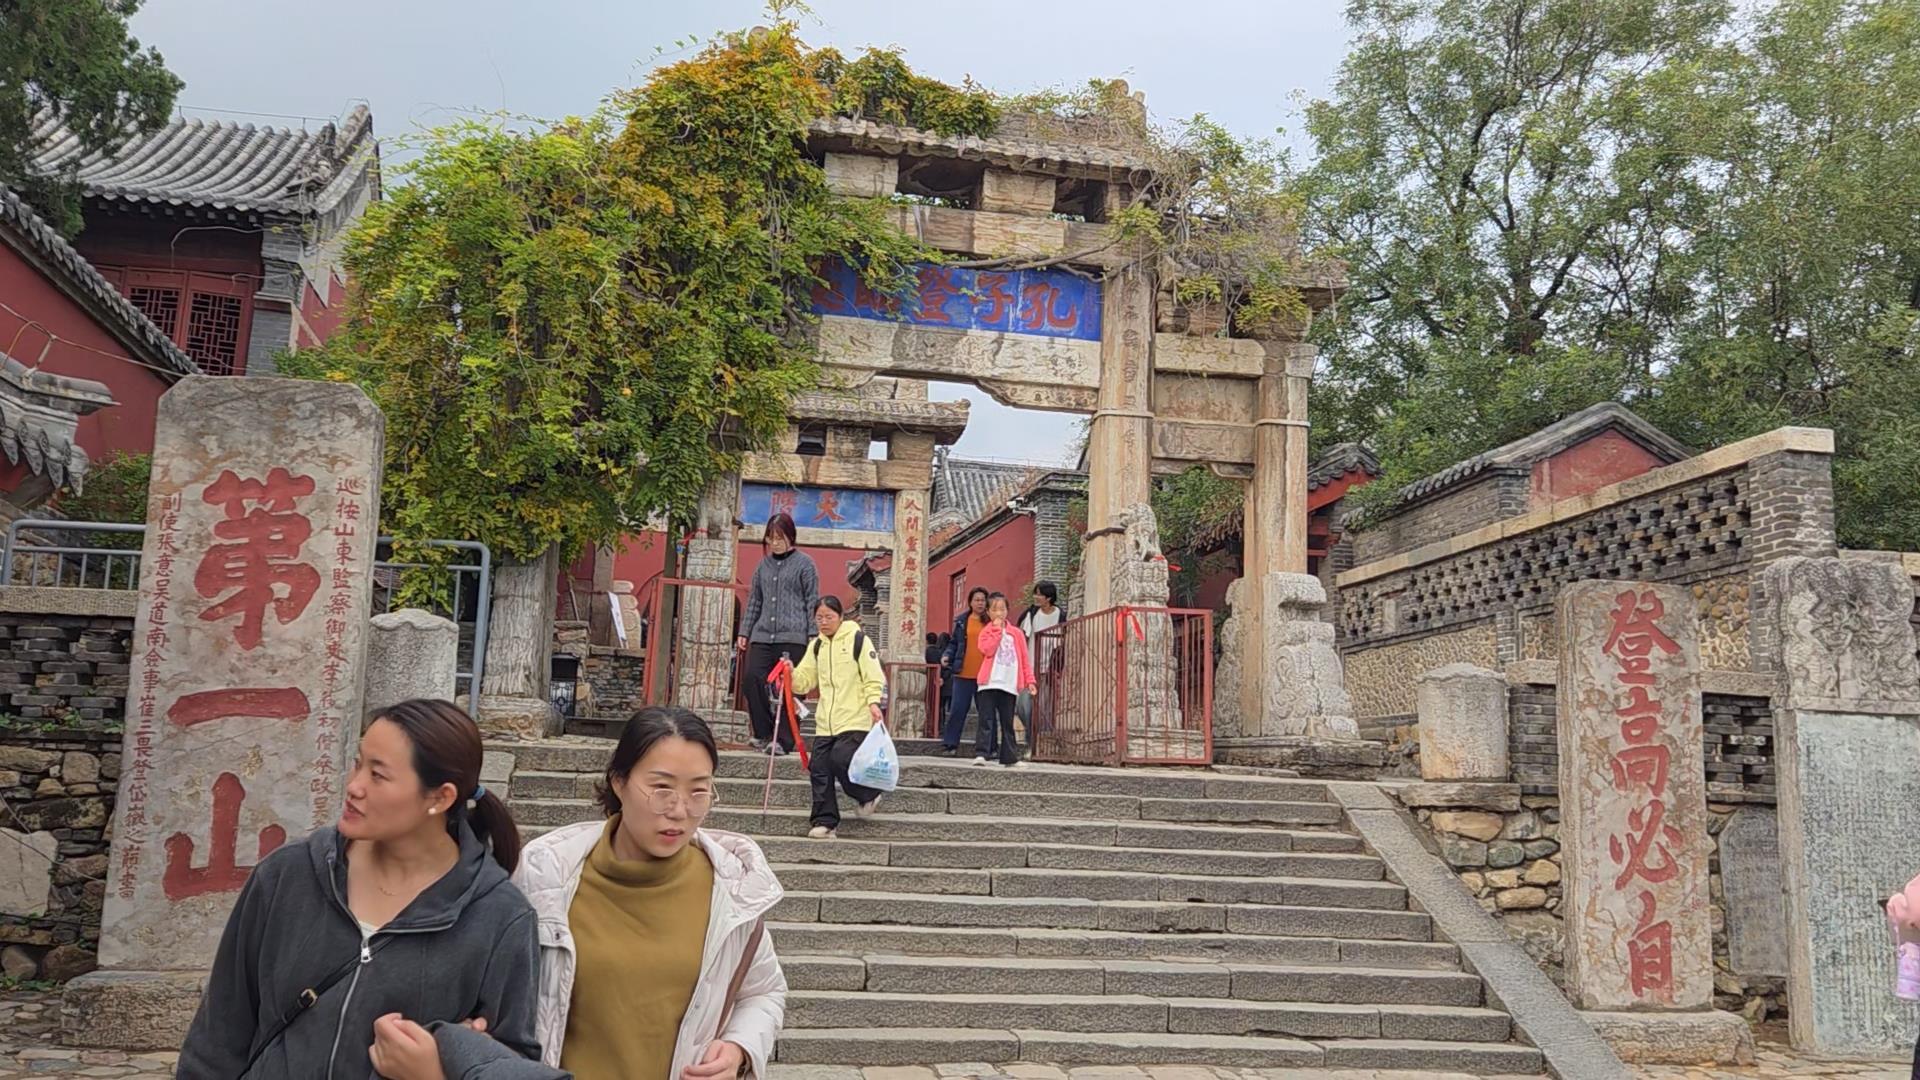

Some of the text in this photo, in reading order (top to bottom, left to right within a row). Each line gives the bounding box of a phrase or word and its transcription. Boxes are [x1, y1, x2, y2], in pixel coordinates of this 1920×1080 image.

[162, 466, 321, 901] 第一山
[1602, 588, 1682, 1002] 登高必自
